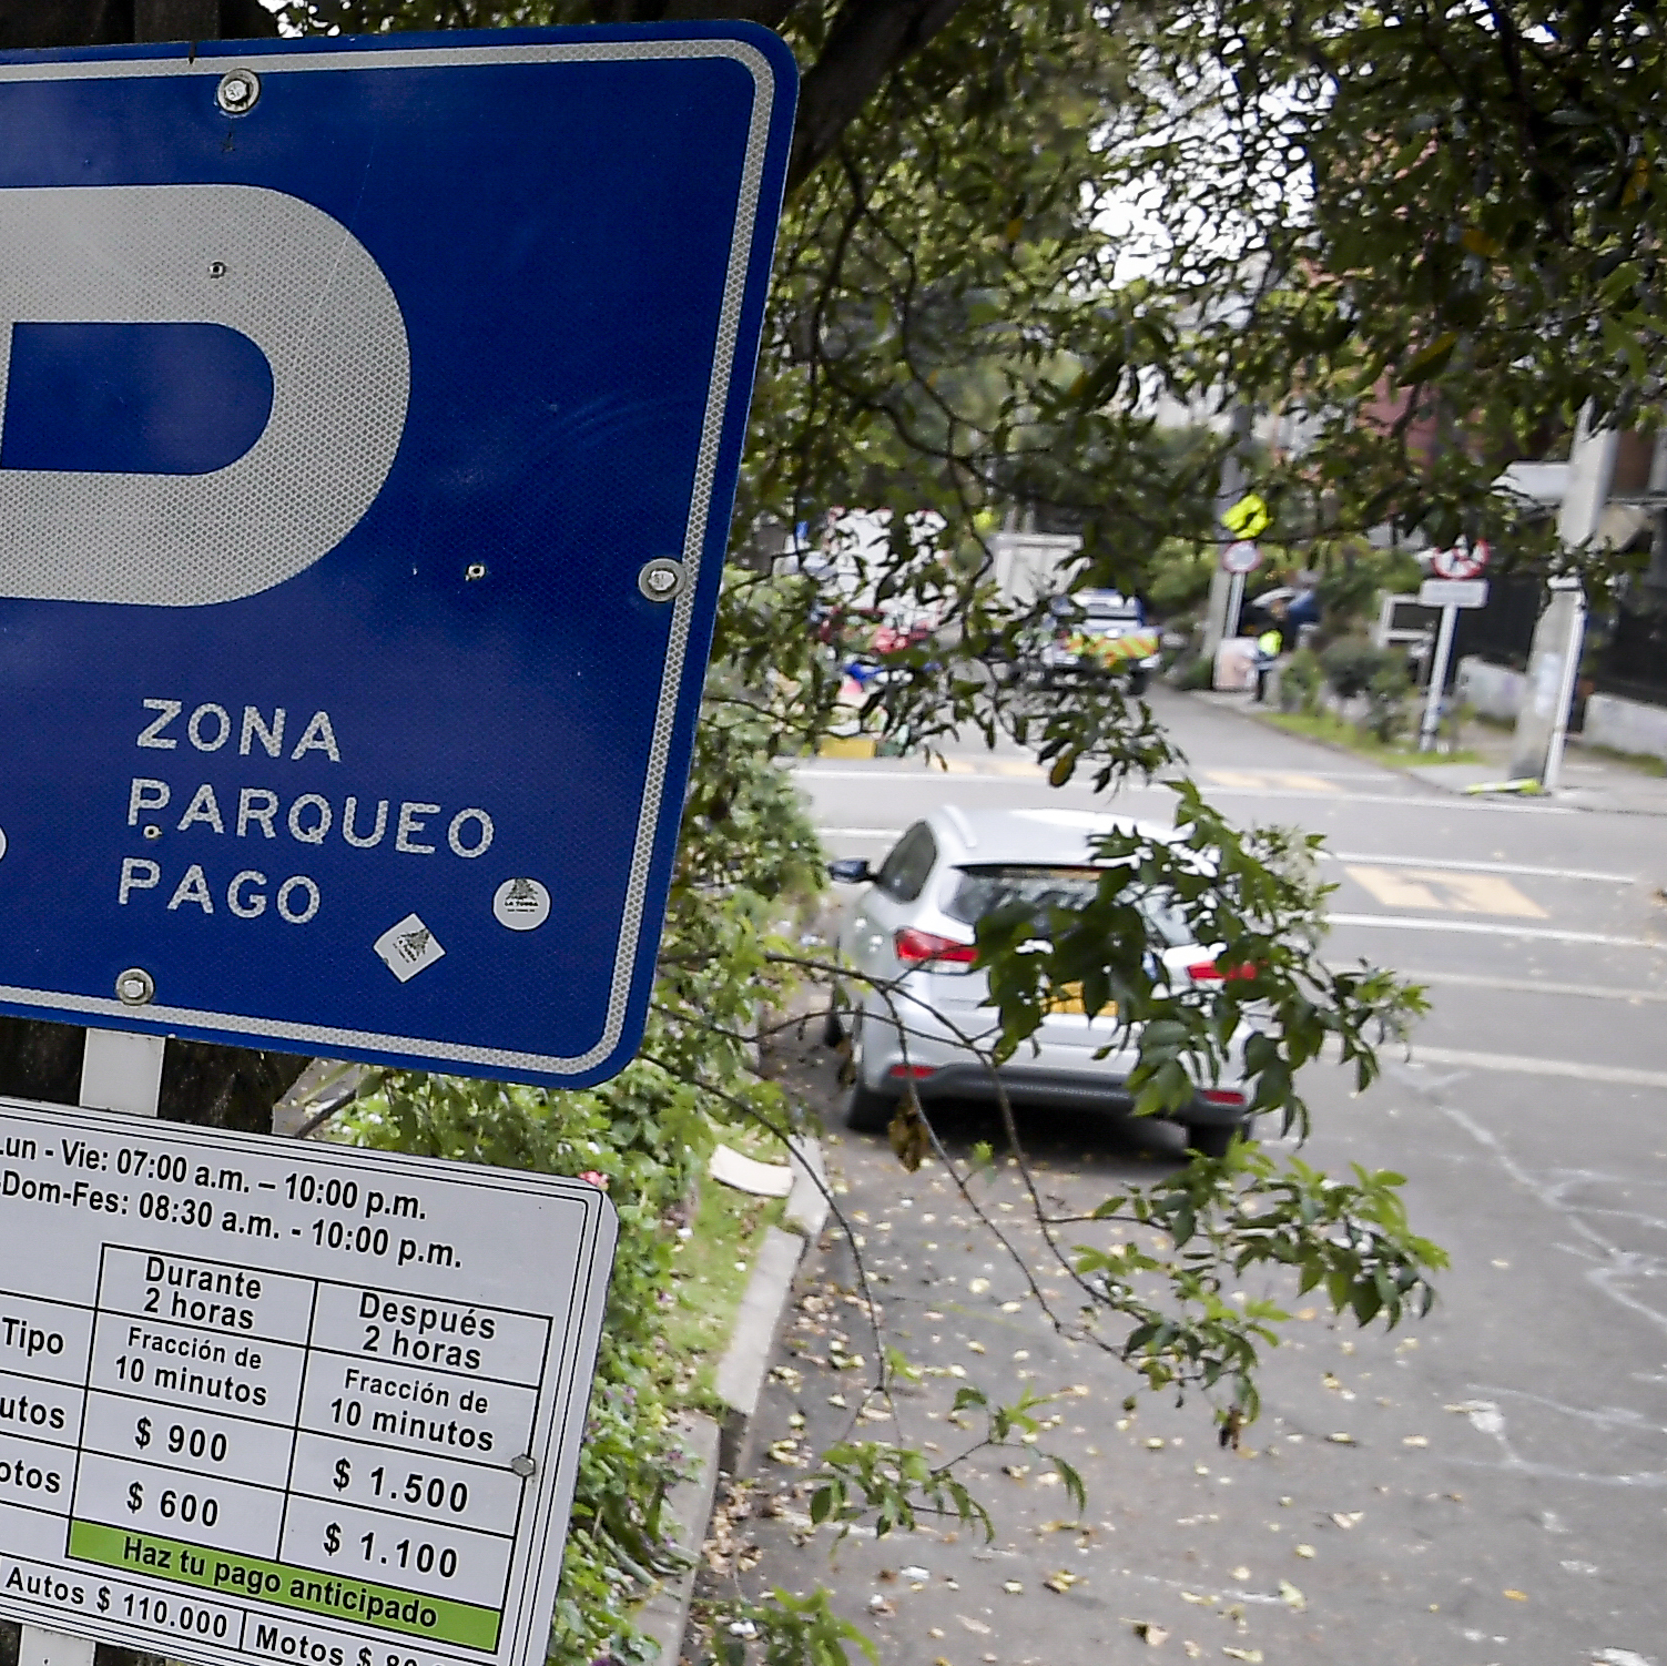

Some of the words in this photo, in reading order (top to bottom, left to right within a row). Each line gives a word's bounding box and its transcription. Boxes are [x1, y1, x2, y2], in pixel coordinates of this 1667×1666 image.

[137, 697, 342, 763] ZONA
[127, 777, 495, 859] PARQUEO
[118, 857, 321, 924] PAGO
[61, 1138, 108, 1171] Vie:
[117, 1147, 188, 1183] 07:00
[194, 1165, 250, 1193] a.m.
[284, 1172, 358, 1209] 10:00
[364, 1190, 427, 1220] p.m.
[139, 1191, 213, 1228] 08:30
[221, 1210, 280, 1239] a.m.
[312, 1218, 389, 1256] 10:00
[397, 1237, 462, 1268] p.m.
[146, 1256, 262, 1299] Durante
[143, 1287, 161, 1313] 2
[171, 1291, 254, 1330] horas
[358, 1291, 496, 1340] Después
[1, 1316, 64, 1357] Tipo
[127, 1326, 226, 1363] Fracción
[234, 1347, 262, 1369] de
[362, 1325, 380, 1352] 2
[392, 1329, 481, 1370] horas
[115, 1355, 144, 1383] 10
[155, 1366, 267, 1406] minutos
[344, 1368, 450, 1408] Fracción
[459, 1390, 488, 1414] de
[135, 1416, 152, 1450] $
[168, 1424, 228, 1462] 900
[331, 1397, 362, 1426] 10
[372, 1410, 494, 1452] minutos
[127, 1481, 144, 1514] $
[160, 1489, 218, 1527] 600
[333, 1457, 351, 1492] $
[370, 1466, 469, 1513] 1.500
[323, 1522, 342, 1556] $
[360, 1531, 458, 1579] 1.100
[5, 1566, 85, 1605] Autos
[96, 1585, 111, 1612] $
[123, 1592, 228, 1638] 110.000
[124, 1536, 171, 1569] Haz
[179, 1549, 206, 1576] tu
[213, 1561, 281, 1595] pago
[289, 1578, 437, 1627] anticipado
[255, 1624, 344, 1666] Motos
